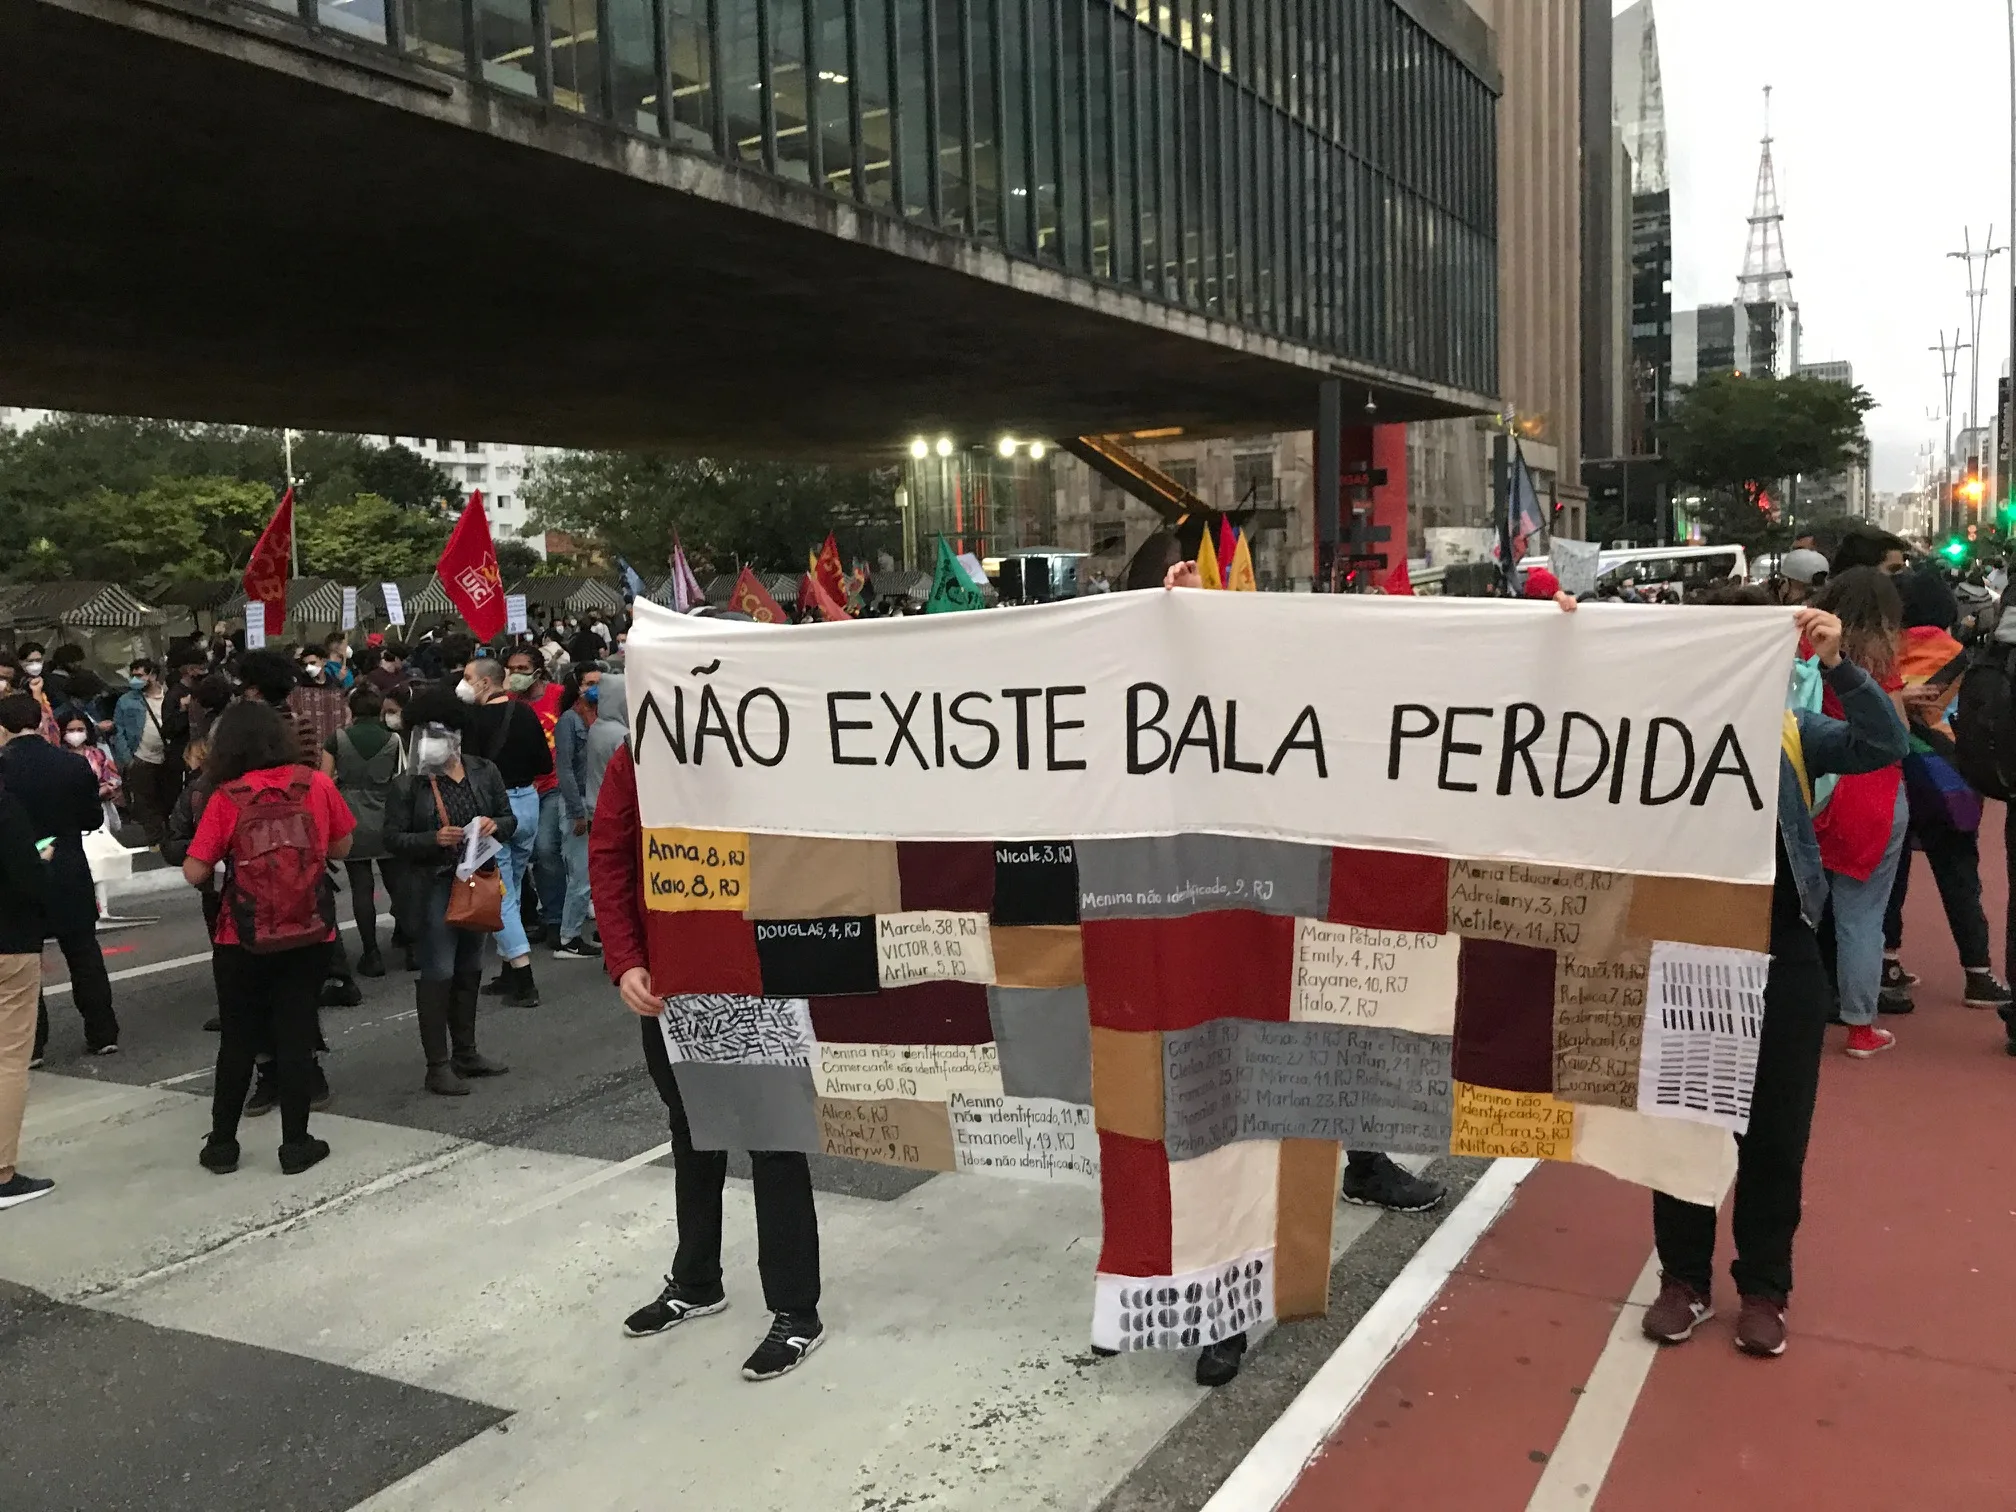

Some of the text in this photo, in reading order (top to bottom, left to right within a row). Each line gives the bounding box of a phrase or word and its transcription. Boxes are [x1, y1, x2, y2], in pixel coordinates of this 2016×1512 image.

[461, 575, 488, 601] UJC
[635, 658, 1765, 811] NÃO EXISTE BALA PERDIDA
[729, 850, 745, 866] RJ
[1058, 846, 1073, 864] RJ
[720, 879, 740, 897] RJ
[1591, 871, 1613, 891] RJ
[1082, 892, 1133, 909] Menina
[1137, 889, 1162, 905] não
[1253, 879, 1274, 900] RJ
[1561, 895, 1587, 916] RJ
[843, 921, 861, 938] RJ
[960, 917, 977, 935] RJ
[1553, 922, 1581, 944] RJ
[1300, 925, 1345, 942] Maria
[1414, 933, 1438, 949] RJ
[946, 940, 962, 957] RJ
[952, 960, 967, 977] RJ
[1372, 952, 1396, 971] RJ
[1385, 976, 1408, 993] RJ
[1623, 988, 1644, 1006] RJ
[1356, 998, 1379, 1018] RJ
[821, 1046, 868, 1059] Menina
[872, 1046, 897, 1059] não
[982, 1047, 996, 1060] RJ
[1420, 1058, 1441, 1076] RJ
[1607, 1059, 1627, 1077] RJ
[900, 1078, 917, 1096] RJ
[1428, 1079, 1448, 1096] RJ
[1462, 1083, 1541, 1107] Menino não
[951, 1093, 1004, 1108] Menino
[1339, 1090, 1359, 1108] RJ
[871, 1105, 888, 1122] RJ
[953, 1109, 982, 1123] não
[1077, 1108, 1090, 1125] RJ
[1557, 1108, 1573, 1125] RJ
[882, 1125, 900, 1141] RJ
[1334, 1118, 1355, 1136] RJ
[1552, 1128, 1570, 1141] RJ
[1057, 1132, 1075, 1151] RJ
[1537, 1142, 1555, 1156] RJ
[903, 1145, 919, 1163] RJ
[962, 1150, 993, 1167] Idoso
[995, 1154, 1016, 1167] não
